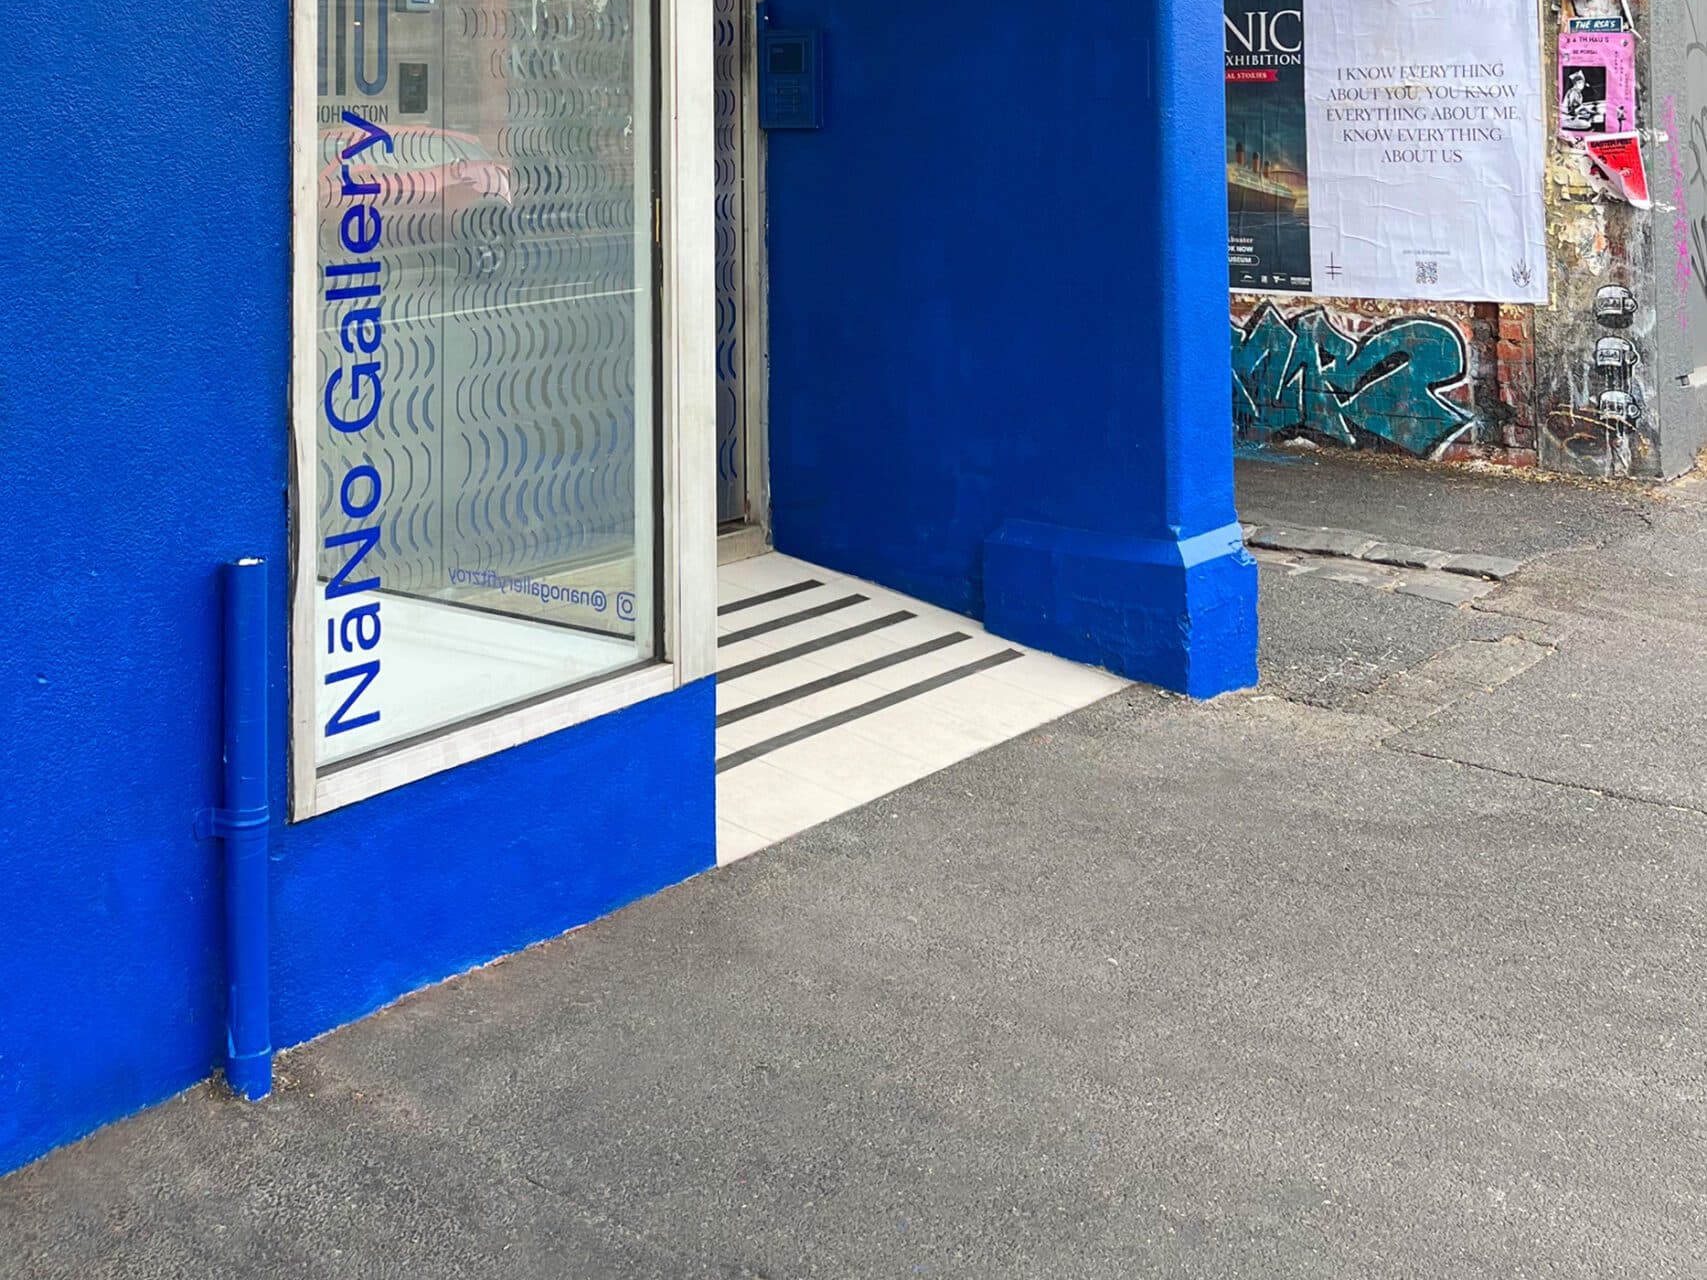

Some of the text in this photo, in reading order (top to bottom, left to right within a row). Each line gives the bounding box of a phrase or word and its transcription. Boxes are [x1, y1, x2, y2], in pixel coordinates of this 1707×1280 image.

[1575, 20, 1591, 29] THE
[1226, 54, 1301, 66] XHIBITION
[1337, 63, 1504, 80] I KNOW EVERYTHING
[1326, 87, 1379, 101] ABOUT
[1425, 85, 1460, 99] YOU
[1465, 84, 1519, 99] KNOW
[1326, 107, 1426, 121] EVERYTHING
[1431, 106, 1488, 120] ABOUT
[1343, 127, 1502, 142] KNOW EVERYTHING
[1381, 149, 1463, 163] ABOUT US
[324, 111, 394, 433] Gallery
